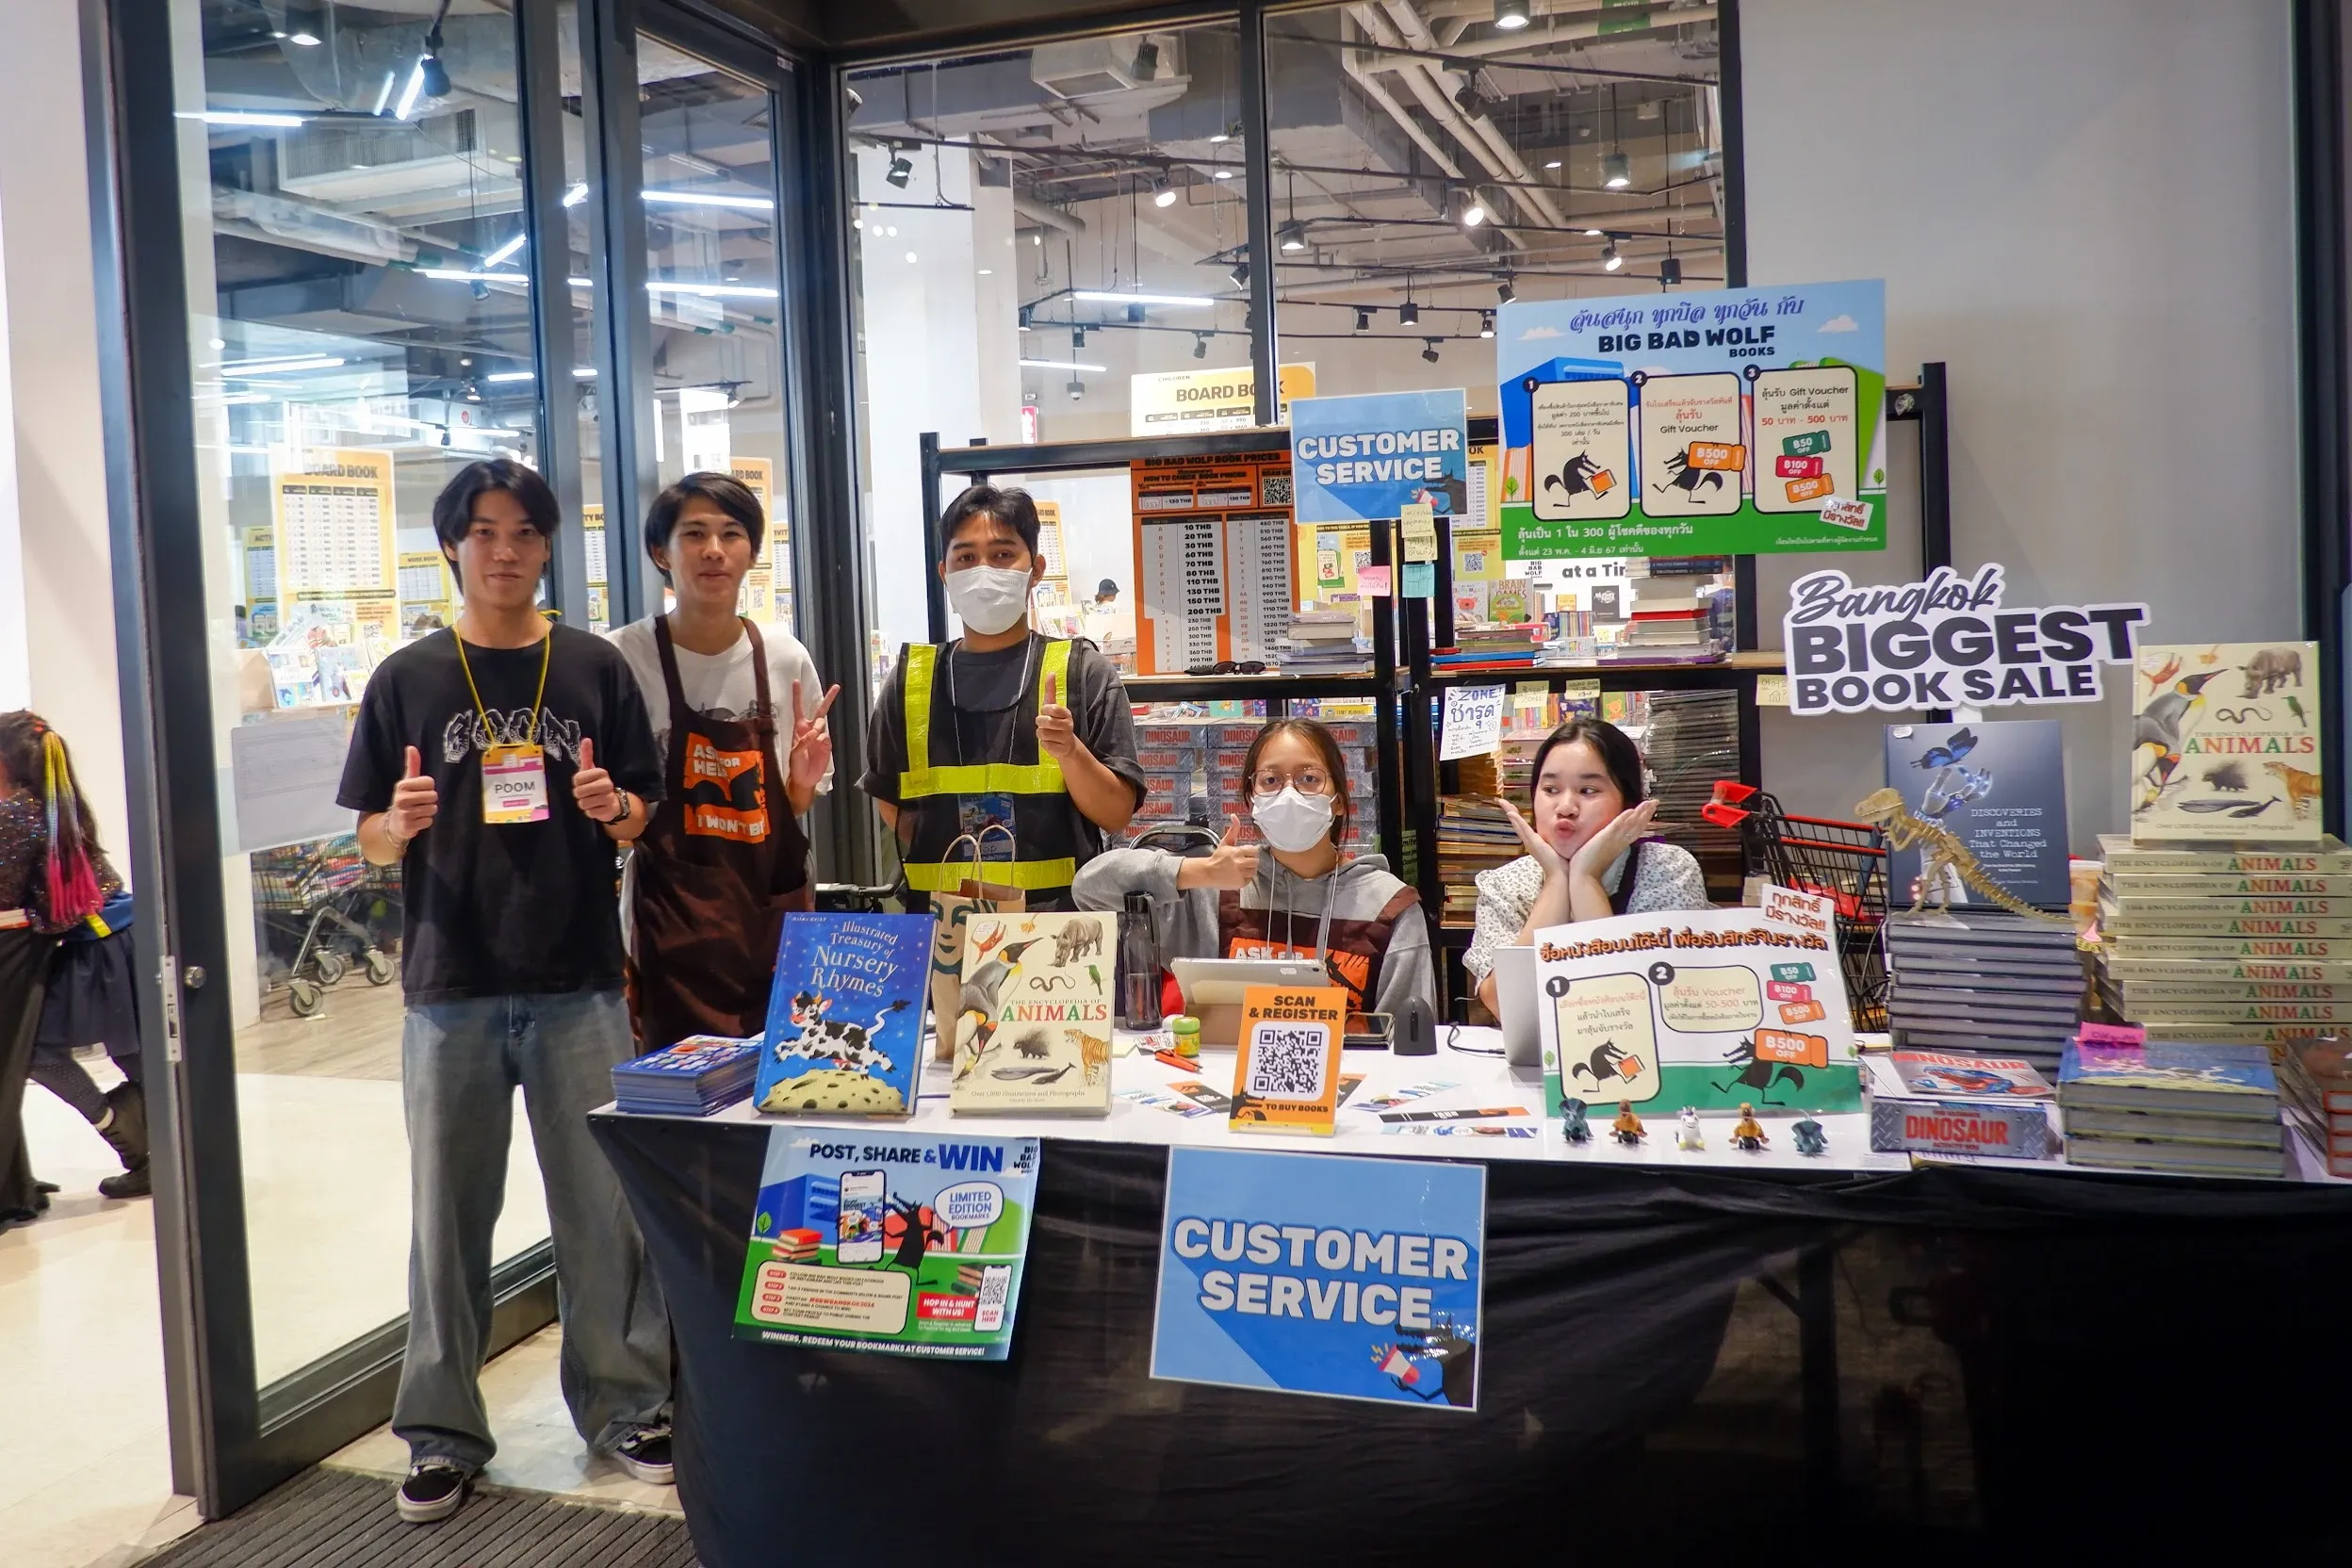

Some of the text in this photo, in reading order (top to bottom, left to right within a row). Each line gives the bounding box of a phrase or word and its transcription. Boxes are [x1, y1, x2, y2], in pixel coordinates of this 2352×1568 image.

[1714, 297, 1768, 325] ทุกวัน
[1776, 295, 1805, 315] กับ
[1598, 325, 1775, 352] BIG BAD WOLF
[1729, 346, 1775, 358] BOOKS
[1176, 384, 1234, 402] BOARD
[1789, 385, 1849, 397] Gift Voucher
[1761, 414, 1848, 426] 50 บาท 500 บาท
[1659, 423, 1719, 434] Gift Voucher
[1298, 430, 1460, 460] CUSTOMER
[1186, 454, 1213, 465] WOLF
[1244, 452, 1282, 462] PRICES
[347, 466, 379, 479] BOOK
[1316, 456, 1443, 485] SERVICE
[1518, 526, 1552, 544] ลุ้นเป็น
[1567, 525, 1578, 538] ใน
[1583, 527, 1604, 538] 300
[1580, 547, 1587, 555] 4
[1562, 566, 1581, 578] at
[1586, 567, 1597, 578] a
[1499, 580, 1526, 590] BRAIN
[1791, 568, 1998, 624] Bangkok
[1792, 608, 2143, 675] BIGGEST
[1797, 664, 2096, 710] BOOK SALE
[1145, 731, 1190, 743] DINOSAUR
[694, 743, 720, 760] AS
[2185, 736, 2315, 754] ANIMALS
[495, 781, 536, 794] POOM
[1970, 808, 2043, 817] DISCOVERIES
[1996, 819, 2017, 827] and
[1974, 828, 2041, 838] INVENTIONS
[1968, 839, 2047, 849] That Changed
[1980, 850, 2037, 858] the World
[2229, 858, 2316, 871] ANIMALS
[2238, 880, 2327, 892] ANIMALS
[2241, 901, 2328, 913] ANIMALS
[841, 921, 899, 944] Illustrated
[2229, 921, 2316, 933] ANIMALS
[829, 932, 895, 959] Treasury of
[2241, 942, 2328, 955] ANIMALS
[811, 945, 899, 983] Nursery
[1657, 967, 1668, 980] 2
[2233, 966, 2323, 979] ANIMALS
[810, 968, 885, 998] Rhymes
[1553, 980, 1562, 994] 1
[1702, 987, 1746, 997] Voucher
[2246, 986, 2332, 998] ANIMALS
[1274, 995, 1315, 1007] SCAN
[1001, 1004, 1108, 1022] ANIMALS
[1249, 1007, 1338, 1021] & REGISTER
[2246, 1006, 2332, 1019] ANIMALS
[1776, 1050, 1796, 1059] OFF
[1279, 1103, 1298, 1112] BUY
[1298, 1104, 1329, 1113] BOOKS
[1905, 1115, 2009, 1145] DINOSAUR
[809, 1143, 1004, 1172] POST, SHARE & WIN
[950, 1191, 992, 1203] LIMITED
[948, 1202, 992, 1215] EDITION
[1173, 1217, 1469, 1281] CUSTOMER
[923, 1298, 940, 1307] HOP
[955, 1299, 975, 1308] HUNT
[1200, 1269, 1433, 1330] SERVICE
[761, 1331, 801, 1344] WINNERS,
[802, 1335, 833, 1348] REDEEM
[834, 1338, 857, 1349] YOUR
[856, 1341, 906, 1353] BOOKMARKS
[916, 1346, 955, 1355] CUSTOMER
[955, 1347, 986, 1357] SERVICE!
